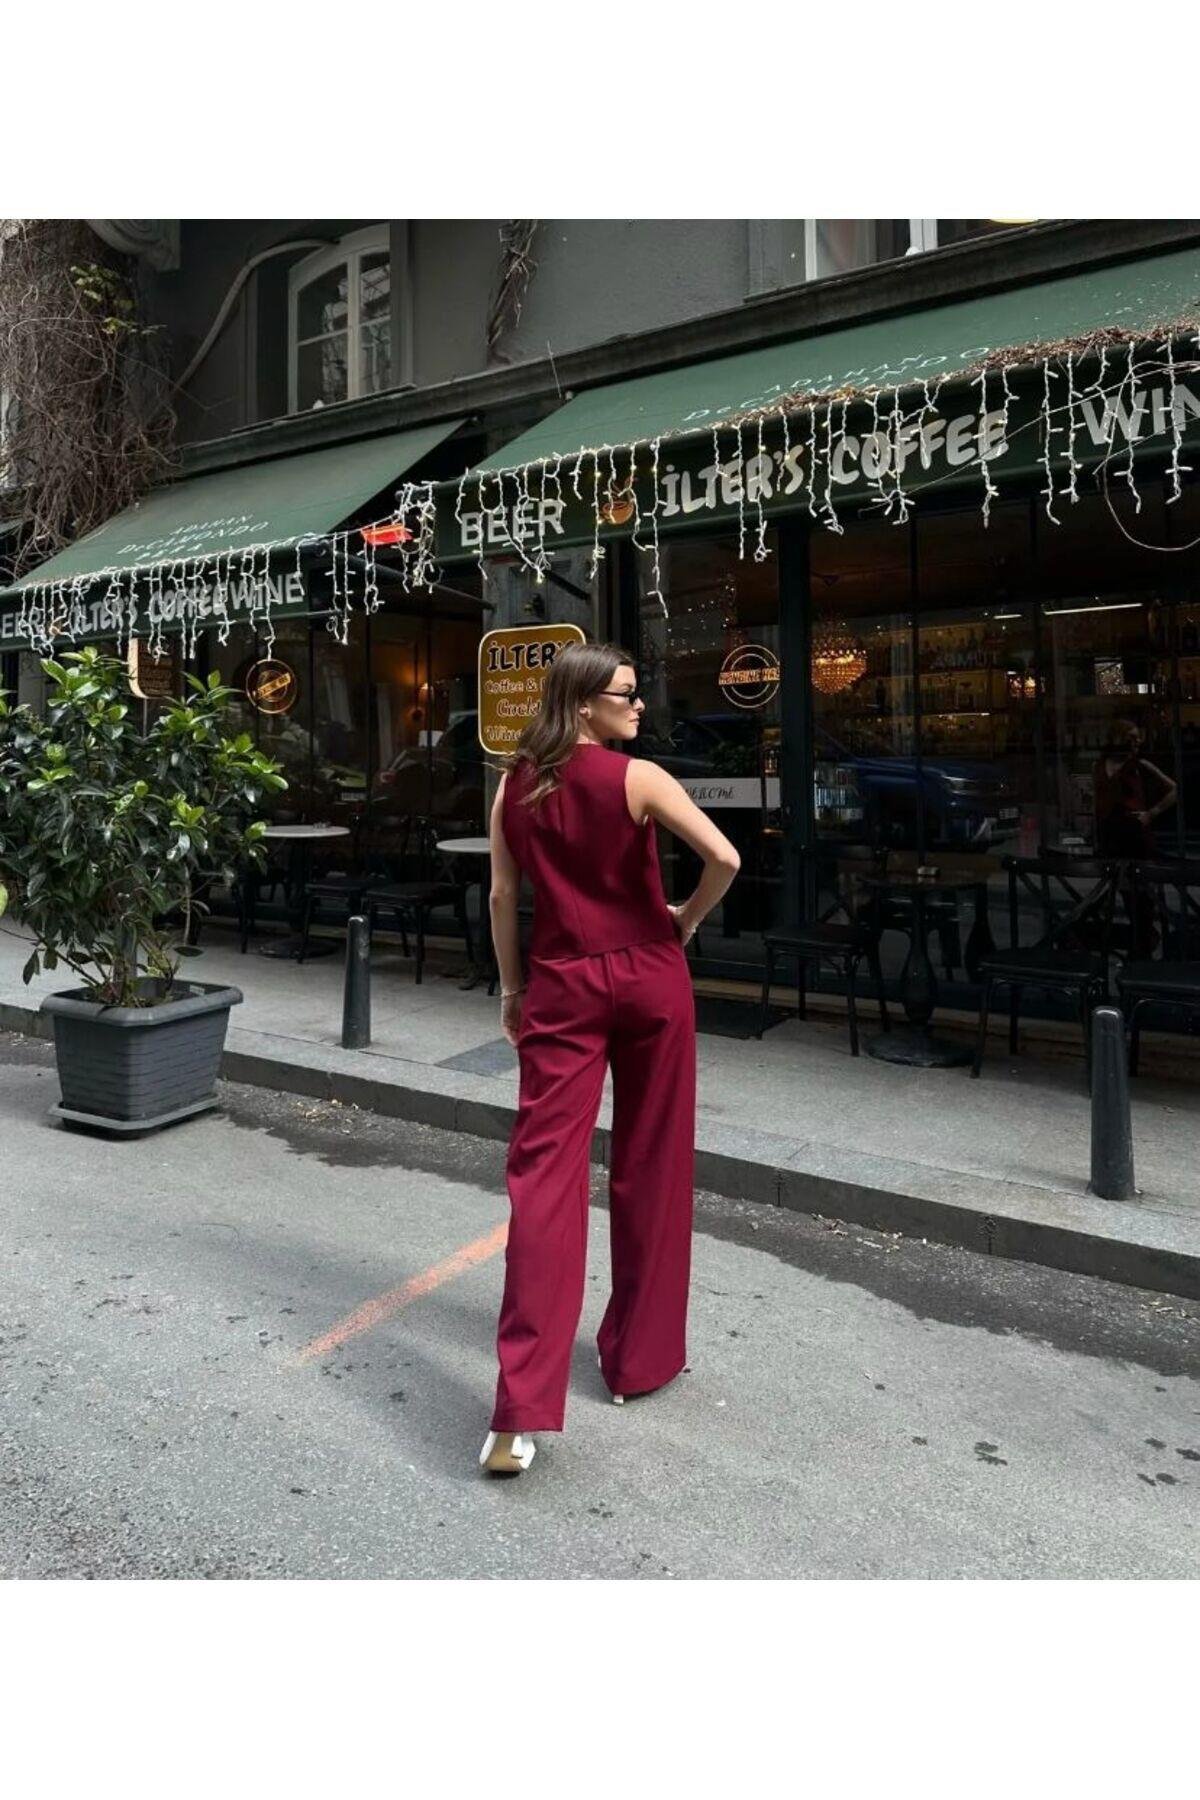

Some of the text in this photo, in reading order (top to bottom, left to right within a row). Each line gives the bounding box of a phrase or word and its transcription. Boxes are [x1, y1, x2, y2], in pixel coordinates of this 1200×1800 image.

[459, 499, 564, 548] BEER
[831, 410, 1009, 485] COFFEE
[229, 571, 305, 610] WINE
[487, 640, 576, 672] İLTER'
[526, 677, 539, 692] &
